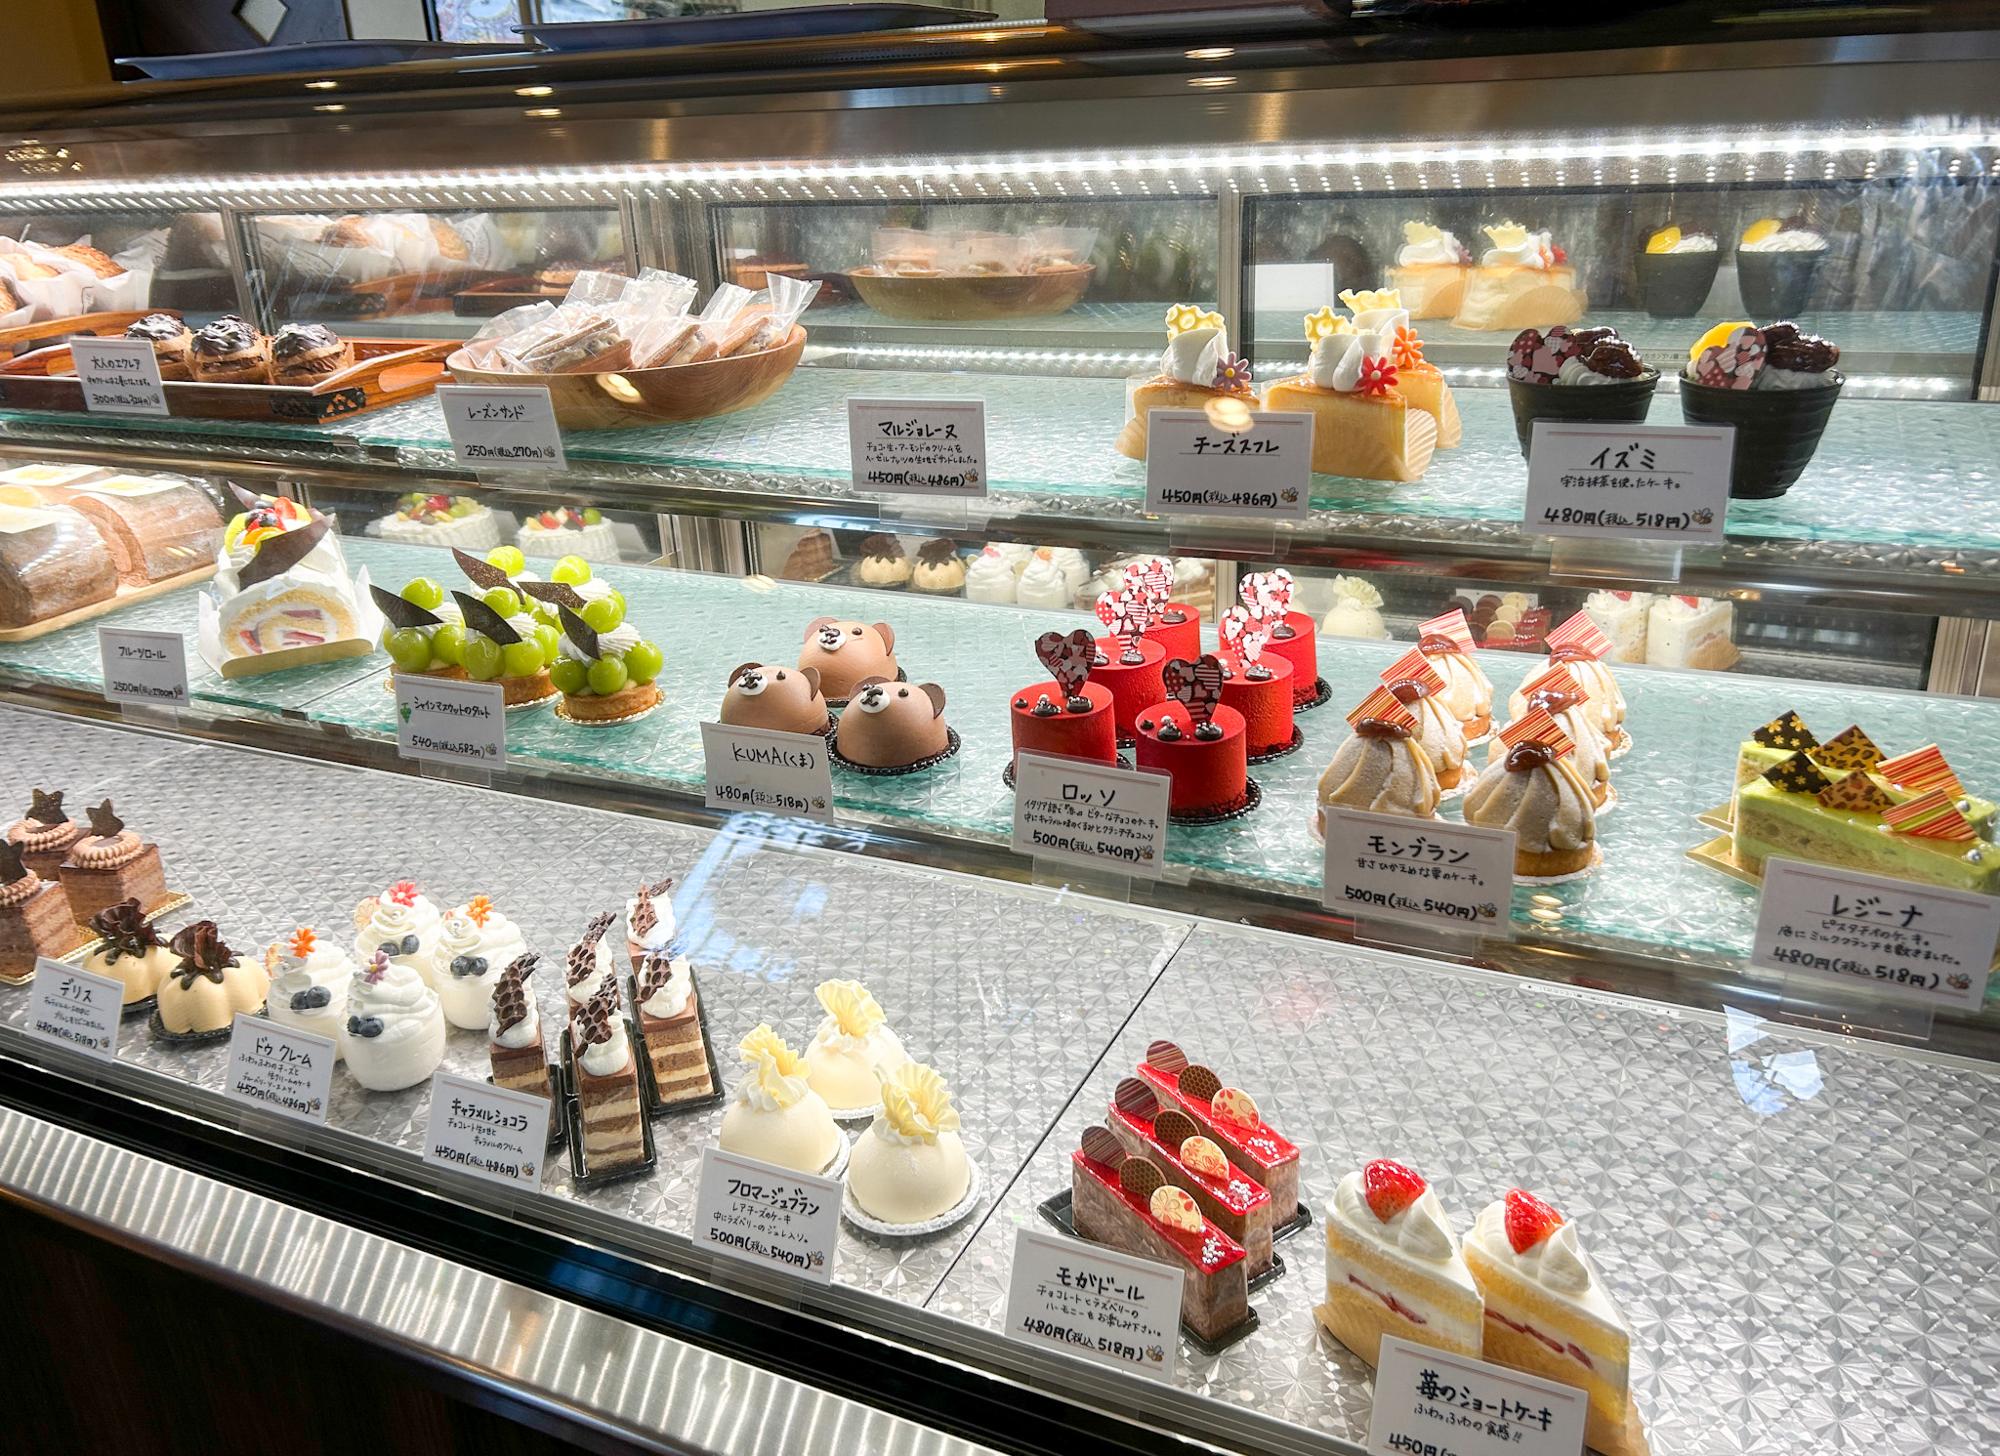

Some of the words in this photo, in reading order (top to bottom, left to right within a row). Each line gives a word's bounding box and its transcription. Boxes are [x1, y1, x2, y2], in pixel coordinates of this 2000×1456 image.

[468, 402, 525, 420] レーズンサンド
[878, 416, 958, 439] マルジョレーヌ
[465, 444, 543, 458] 250円(税込270円)
[1193, 432, 1280, 455] チーズスフレ
[1590, 442, 1656, 470] イズミ
[868, 470, 966, 487] 450円(税込486円)
[1162, 488, 1278, 509] 450円(税込486円)
[1544, 506, 1690, 530] 480円(税込518円)
[118, 646, 167, 659] フルーツロール
[732, 742, 815, 770] KUMA(くま)
[715, 785, 809, 813] 480円(税込518円)
[1062, 783, 1116, 807] ロッソ
[1032, 829, 1140, 862] 500円(税込540円)
[1367, 835, 1470, 864] モンブラン
[1344, 885, 1478, 921] 500円(税込540円)
[1831, 894, 1923, 928] レジーナ
[1773, 945, 1940, 990] 480円(税込518円)
[60, 977, 92, 1003] デリス
[451, 1097, 529, 1132] キャラメルショコラ
[435, 1144, 519, 1178] 450円(税込486円)
[728, 1178, 820, 1216] フロマージュブラン
[710, 1227, 811, 1270] 500円(税込540円)
[1023, 1316, 1144, 1362] 480円(税込518円)
[1416, 1368, 1552, 1432] 苺のショートケーキ
